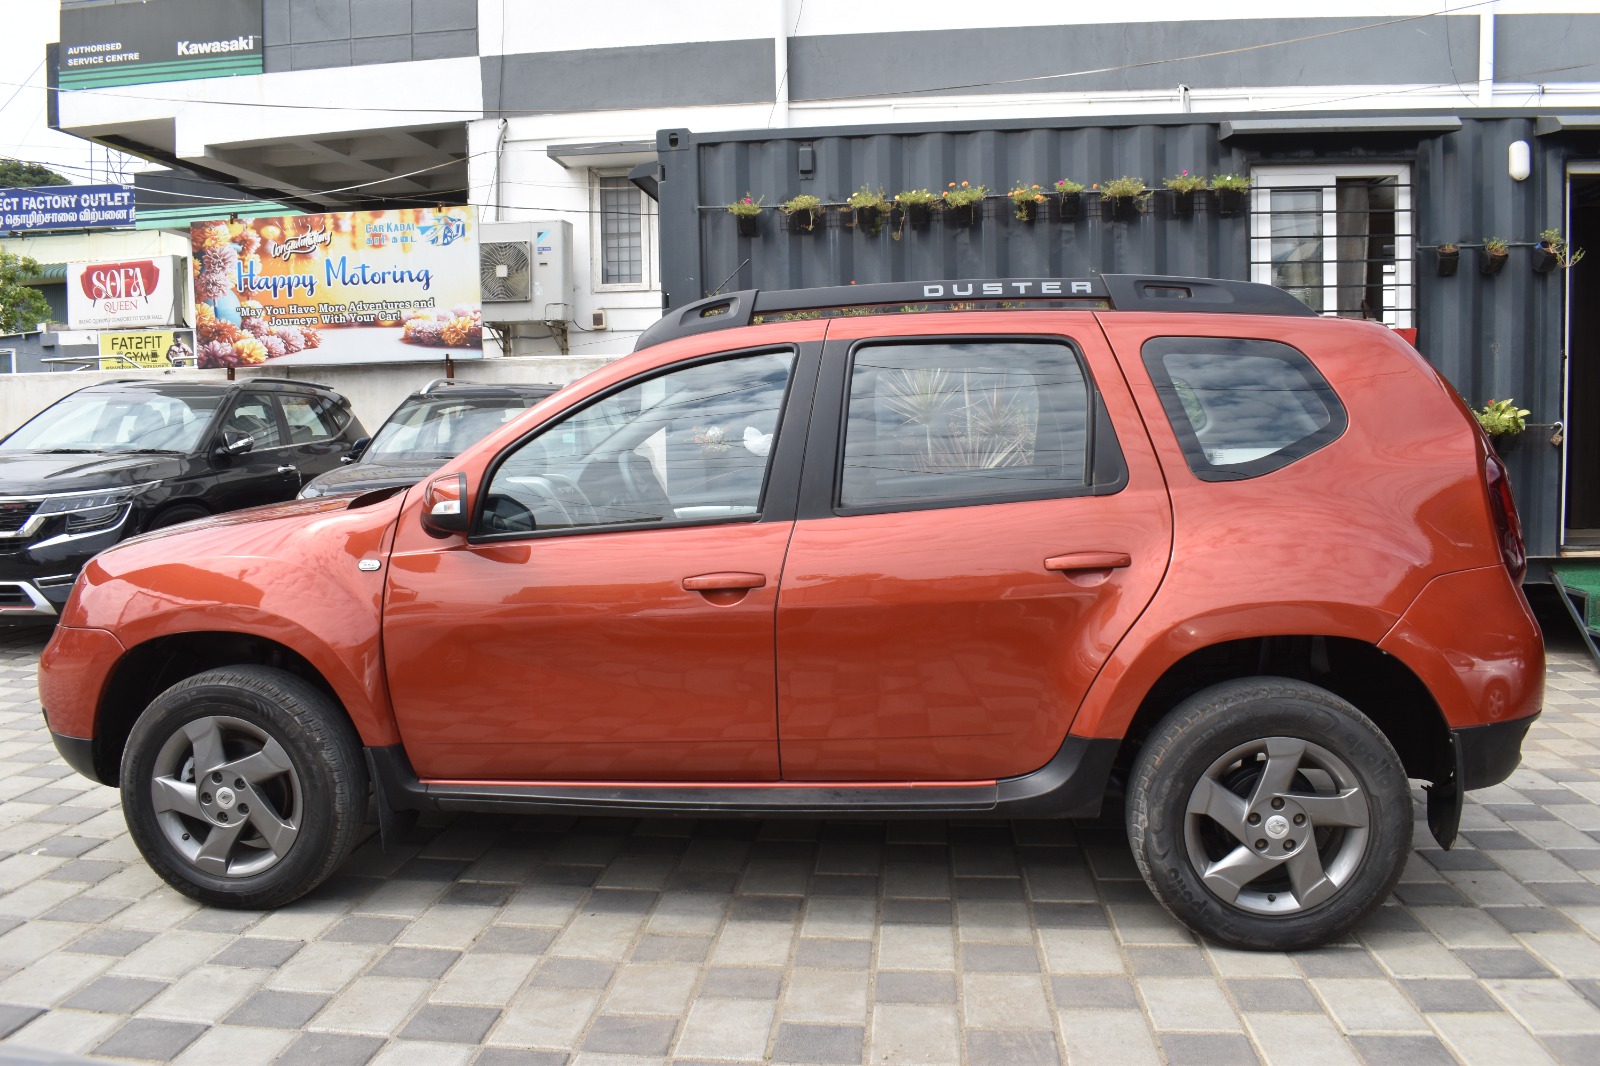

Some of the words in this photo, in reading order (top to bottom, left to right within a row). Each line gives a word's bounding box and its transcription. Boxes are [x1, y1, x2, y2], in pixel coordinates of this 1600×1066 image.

[67, 42, 122, 55] AUTHORISED
[177, 35, 254, 56] Kawasaki
[67, 55, 104, 67] SERVICE
[105, 52, 140, 64] CENTRE
[22, 194, 77, 210] FACTORY
[80, 192, 131, 207] OUTLET
[79, 208, 128, 223] விற்பனை
[92, 267, 147, 300] SOFA
[236, 260, 317, 298] Happy
[325, 256, 433, 291] Motoring
[923, 281, 1092, 297] DUSTER
[104, 300, 138, 314] QUEEN
[265, 305, 287, 316] You
[289, 304, 316, 314] Have
[318, 303, 346, 313] More
[349, 299, 411, 311] Adventures
[413, 297, 435, 308] and
[268, 316, 318, 327] Journeys
[321, 314, 347, 324] With
[349, 313, 375, 323] Your
[111, 335, 162, 350] FAT2FIT
[124, 351, 150, 362] GYM
